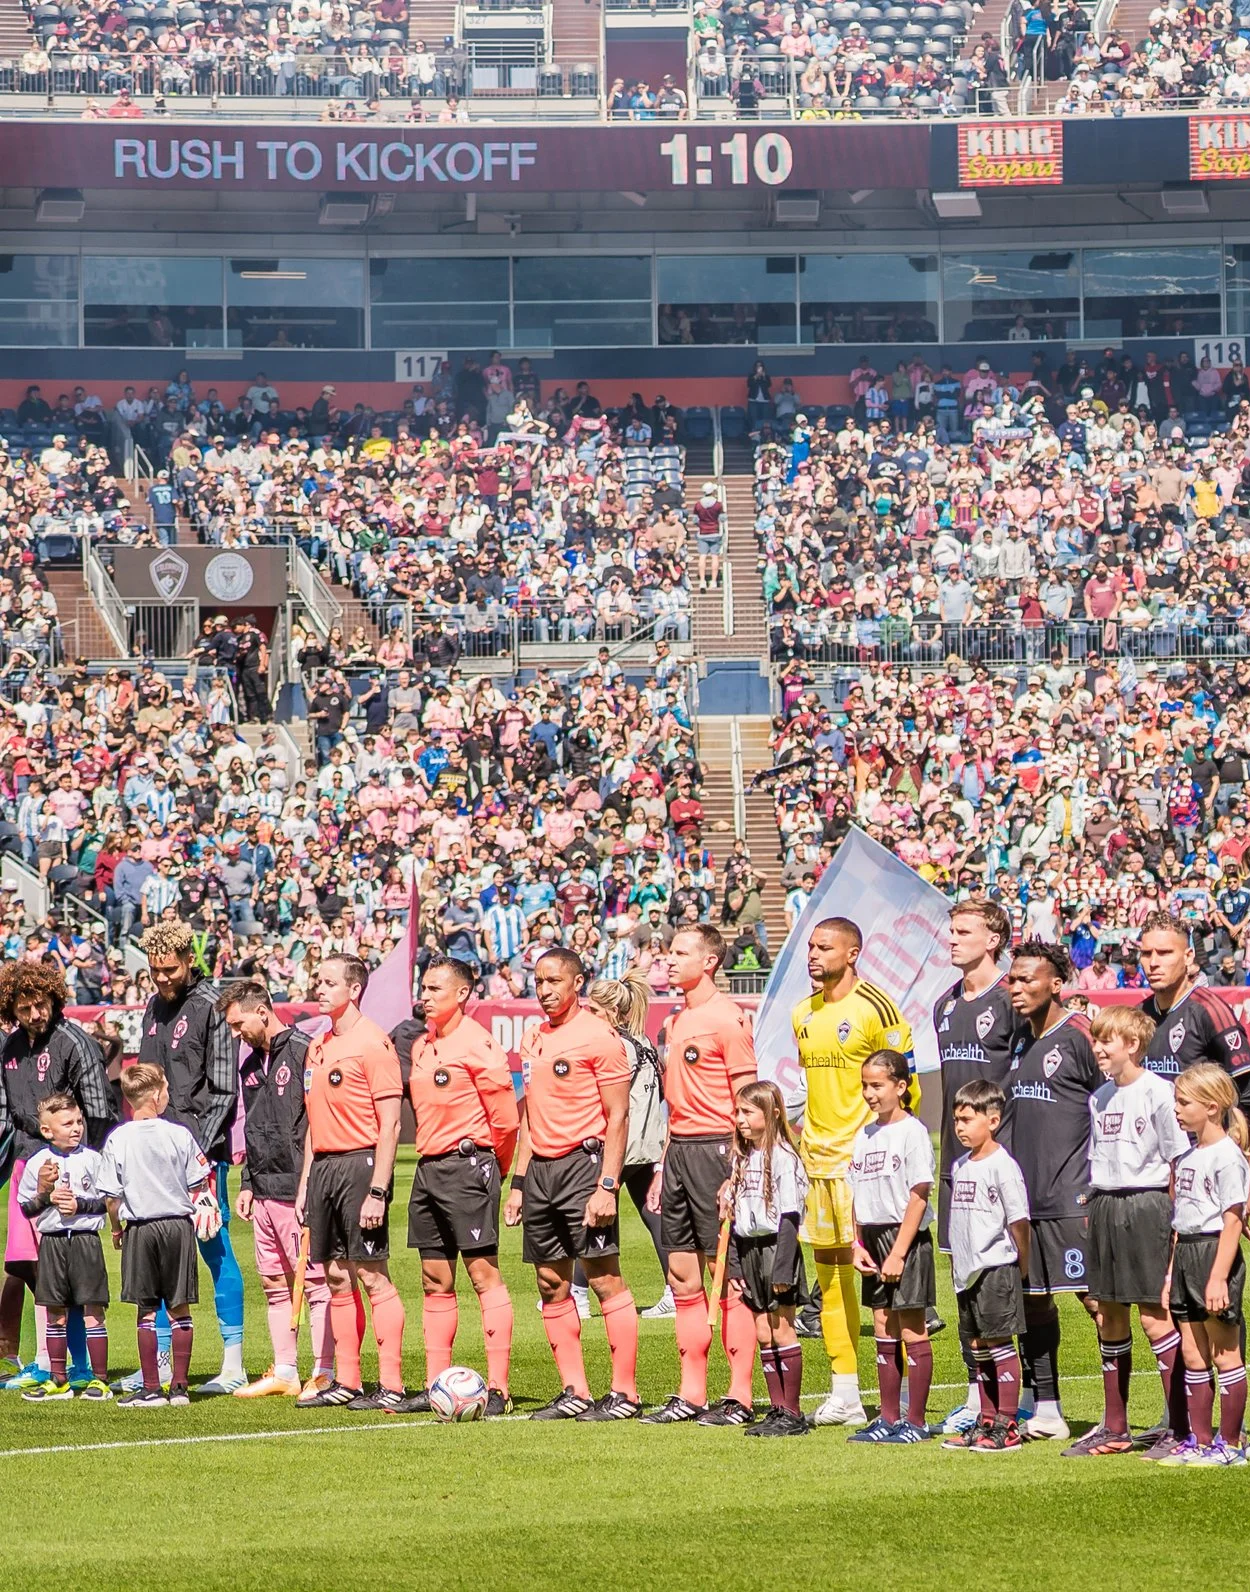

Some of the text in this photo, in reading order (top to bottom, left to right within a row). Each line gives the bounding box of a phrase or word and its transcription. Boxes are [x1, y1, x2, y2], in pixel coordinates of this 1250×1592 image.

[967, 128, 1055, 155] KING
[114, 139, 538, 182] RUSH TO KICKOFF
[660, 132, 793, 185] 1:10
[967, 156, 1055, 184] Soopers
[403, 356, 443, 378] 117
[1201, 342, 1241, 364] 118
[1065, 1248, 1084, 1279] 8
